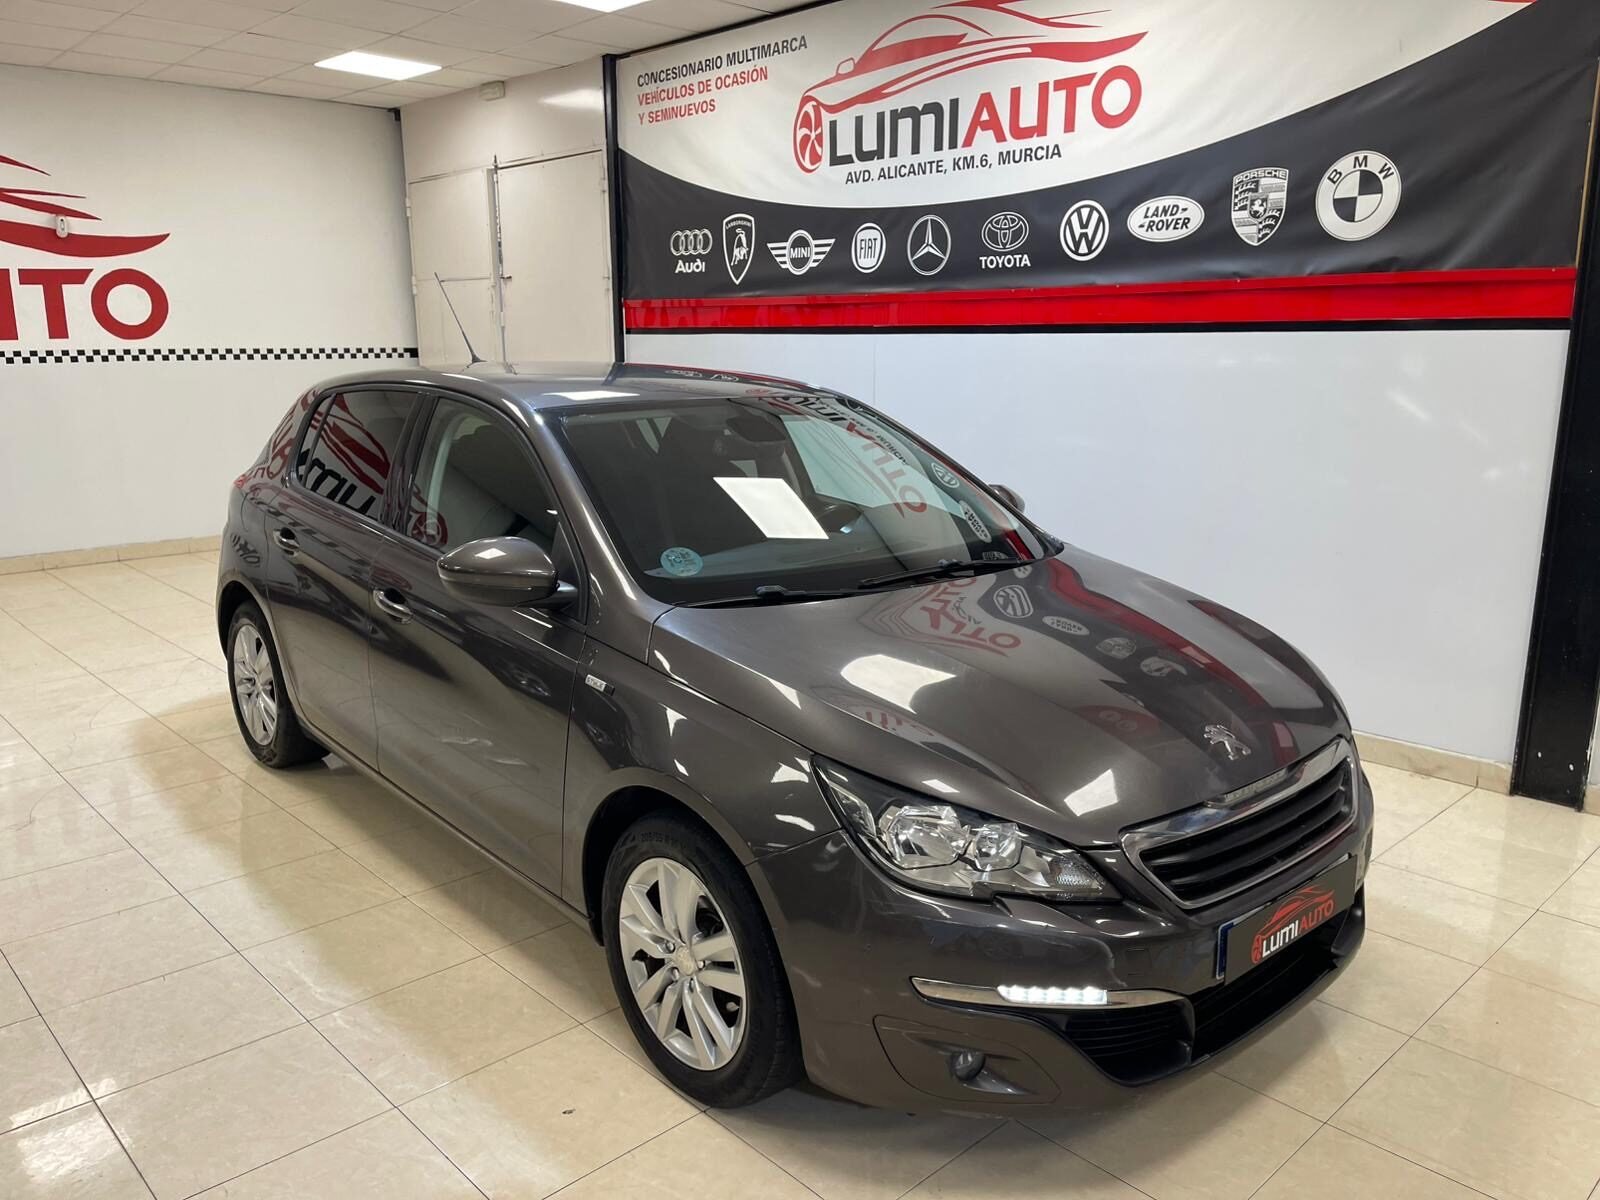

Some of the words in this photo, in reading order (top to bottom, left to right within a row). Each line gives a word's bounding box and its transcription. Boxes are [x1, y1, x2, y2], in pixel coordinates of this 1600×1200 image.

[637, 55, 723, 87] CONCESIONARIO
[726, 35, 808, 70] MULTIMARCA
[637, 82, 695, 107] VEHÍCULOS
[698, 78, 712, 95] DE
[715, 65, 768, 90] OCASIÓN
[638, 112, 646, 125] Y
[648, 99, 716, 124] SEMINUEVOS
[845, 169, 874, 185] AVD.
[878, 159, 948, 181] ALICANTE,
[953, 153, 993, 172] KM.6,
[998, 143, 1062, 167] MURCIA
[1235, 168, 1287, 184] PORSCHE
[1326, 154, 1395, 185] BMW
[790, 246, 811, 260] MINI
[859, 237, 878, 260] FIAT
[675, 258, 706, 274] Audi
[979, 253, 1032, 270] TOYOTA
